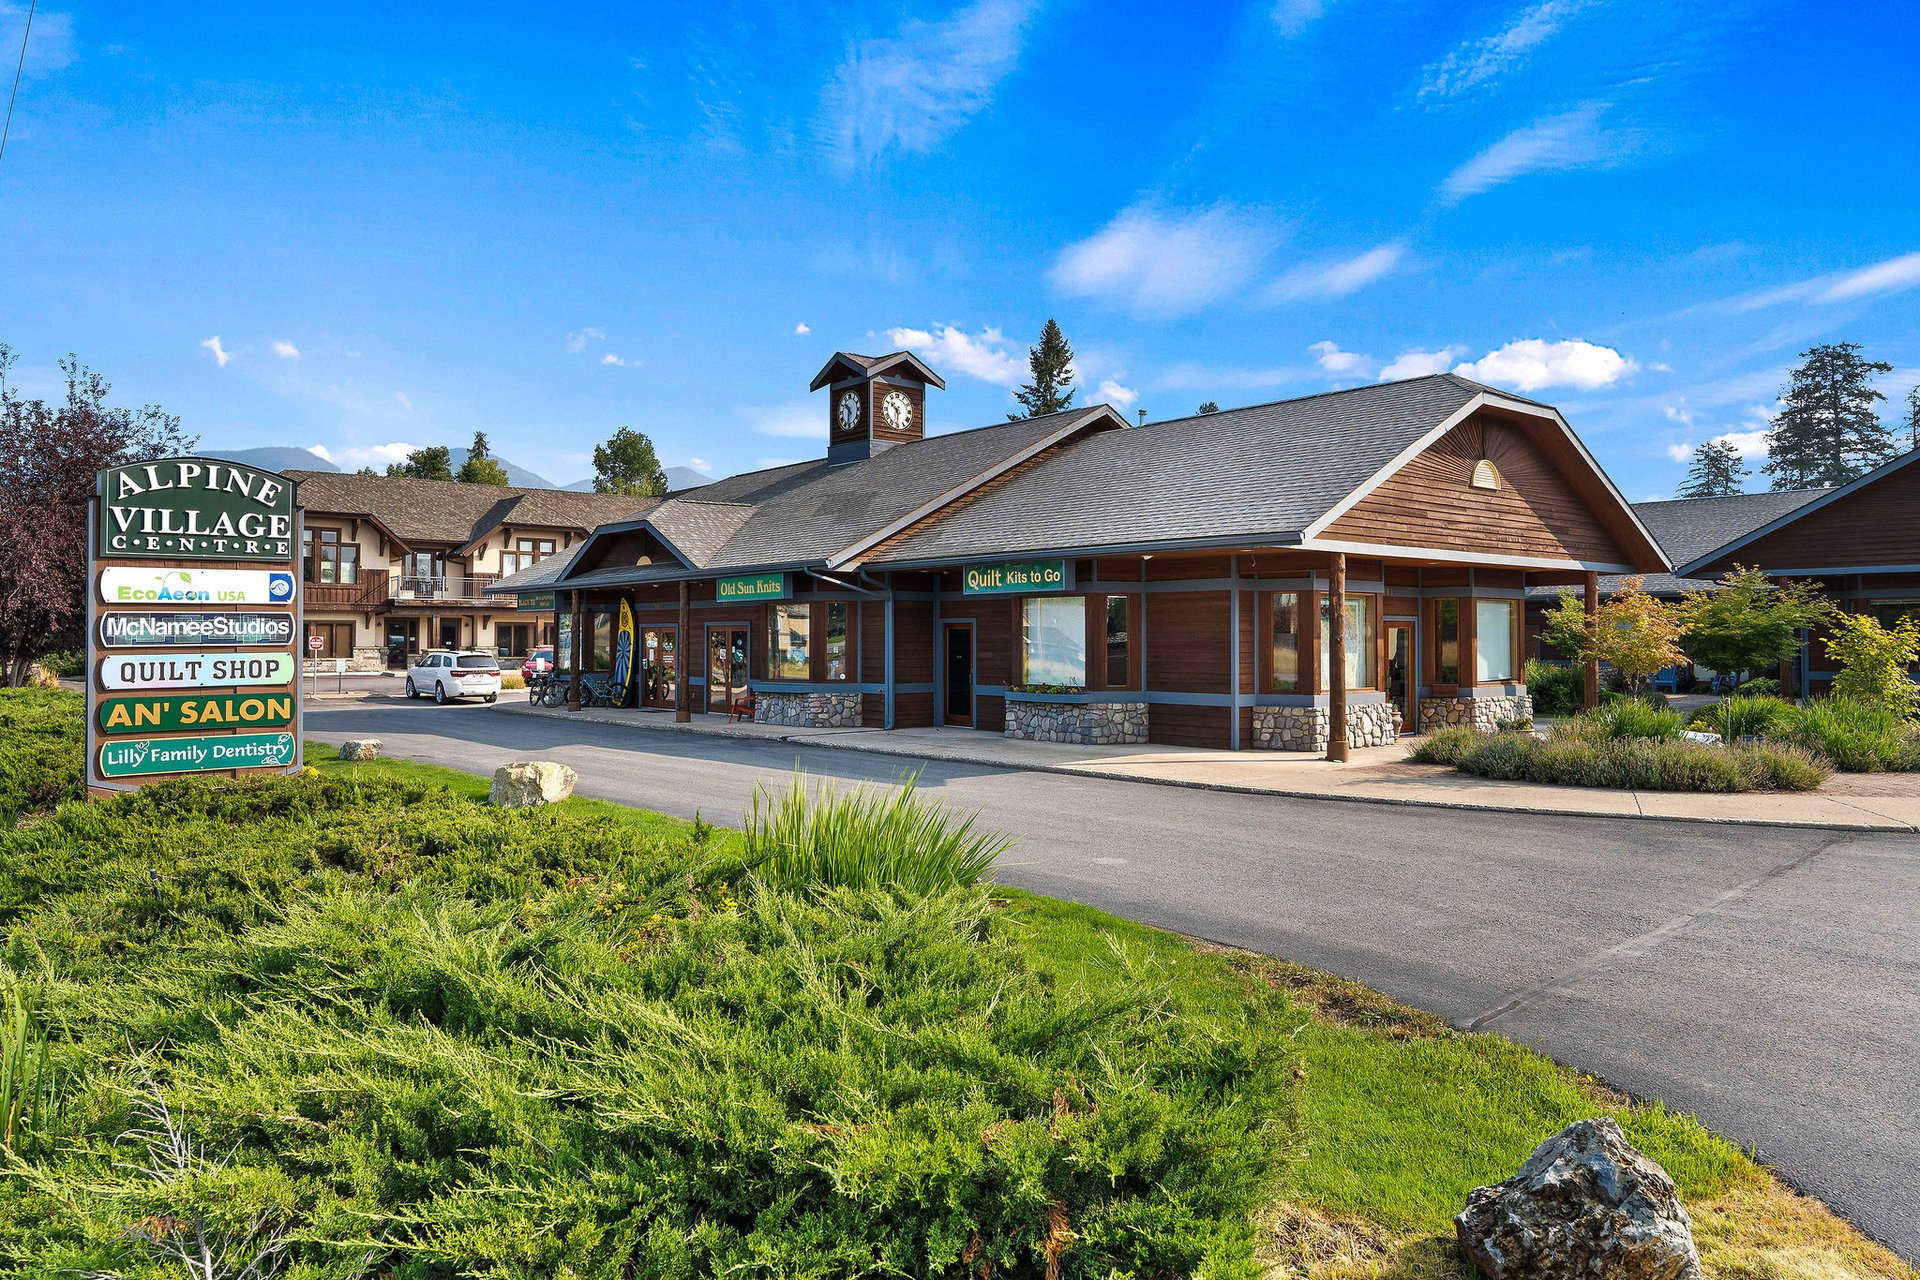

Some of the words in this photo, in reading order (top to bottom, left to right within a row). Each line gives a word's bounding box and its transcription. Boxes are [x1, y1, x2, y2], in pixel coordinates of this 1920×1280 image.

[117, 463, 283, 508] ALPINE
[109, 505, 291, 539] VILLAGE
[720, 582, 736, 596] Old
[737, 581, 755, 595] Sun
[756, 579, 781, 593] Knits
[968, 569, 1002, 590] Quilt
[1006, 571, 1028, 584] Kits
[1030, 570, 1042, 583] to
[1044, 568, 1061, 582] Go
[117, 586, 210, 601] EcoAeon
[217, 591, 246, 602] USA
[106, 616, 290, 637] McNameeStudios
[120, 661, 203, 684] QUILT
[212, 660, 281, 680] SHOP
[106, 702, 170, 728] AN'
[179, 698, 291, 724] SALON
[107, 748, 146, 768] Lilly
[151, 744, 208, 764] Family
[213, 741, 290, 759] Dentistry
